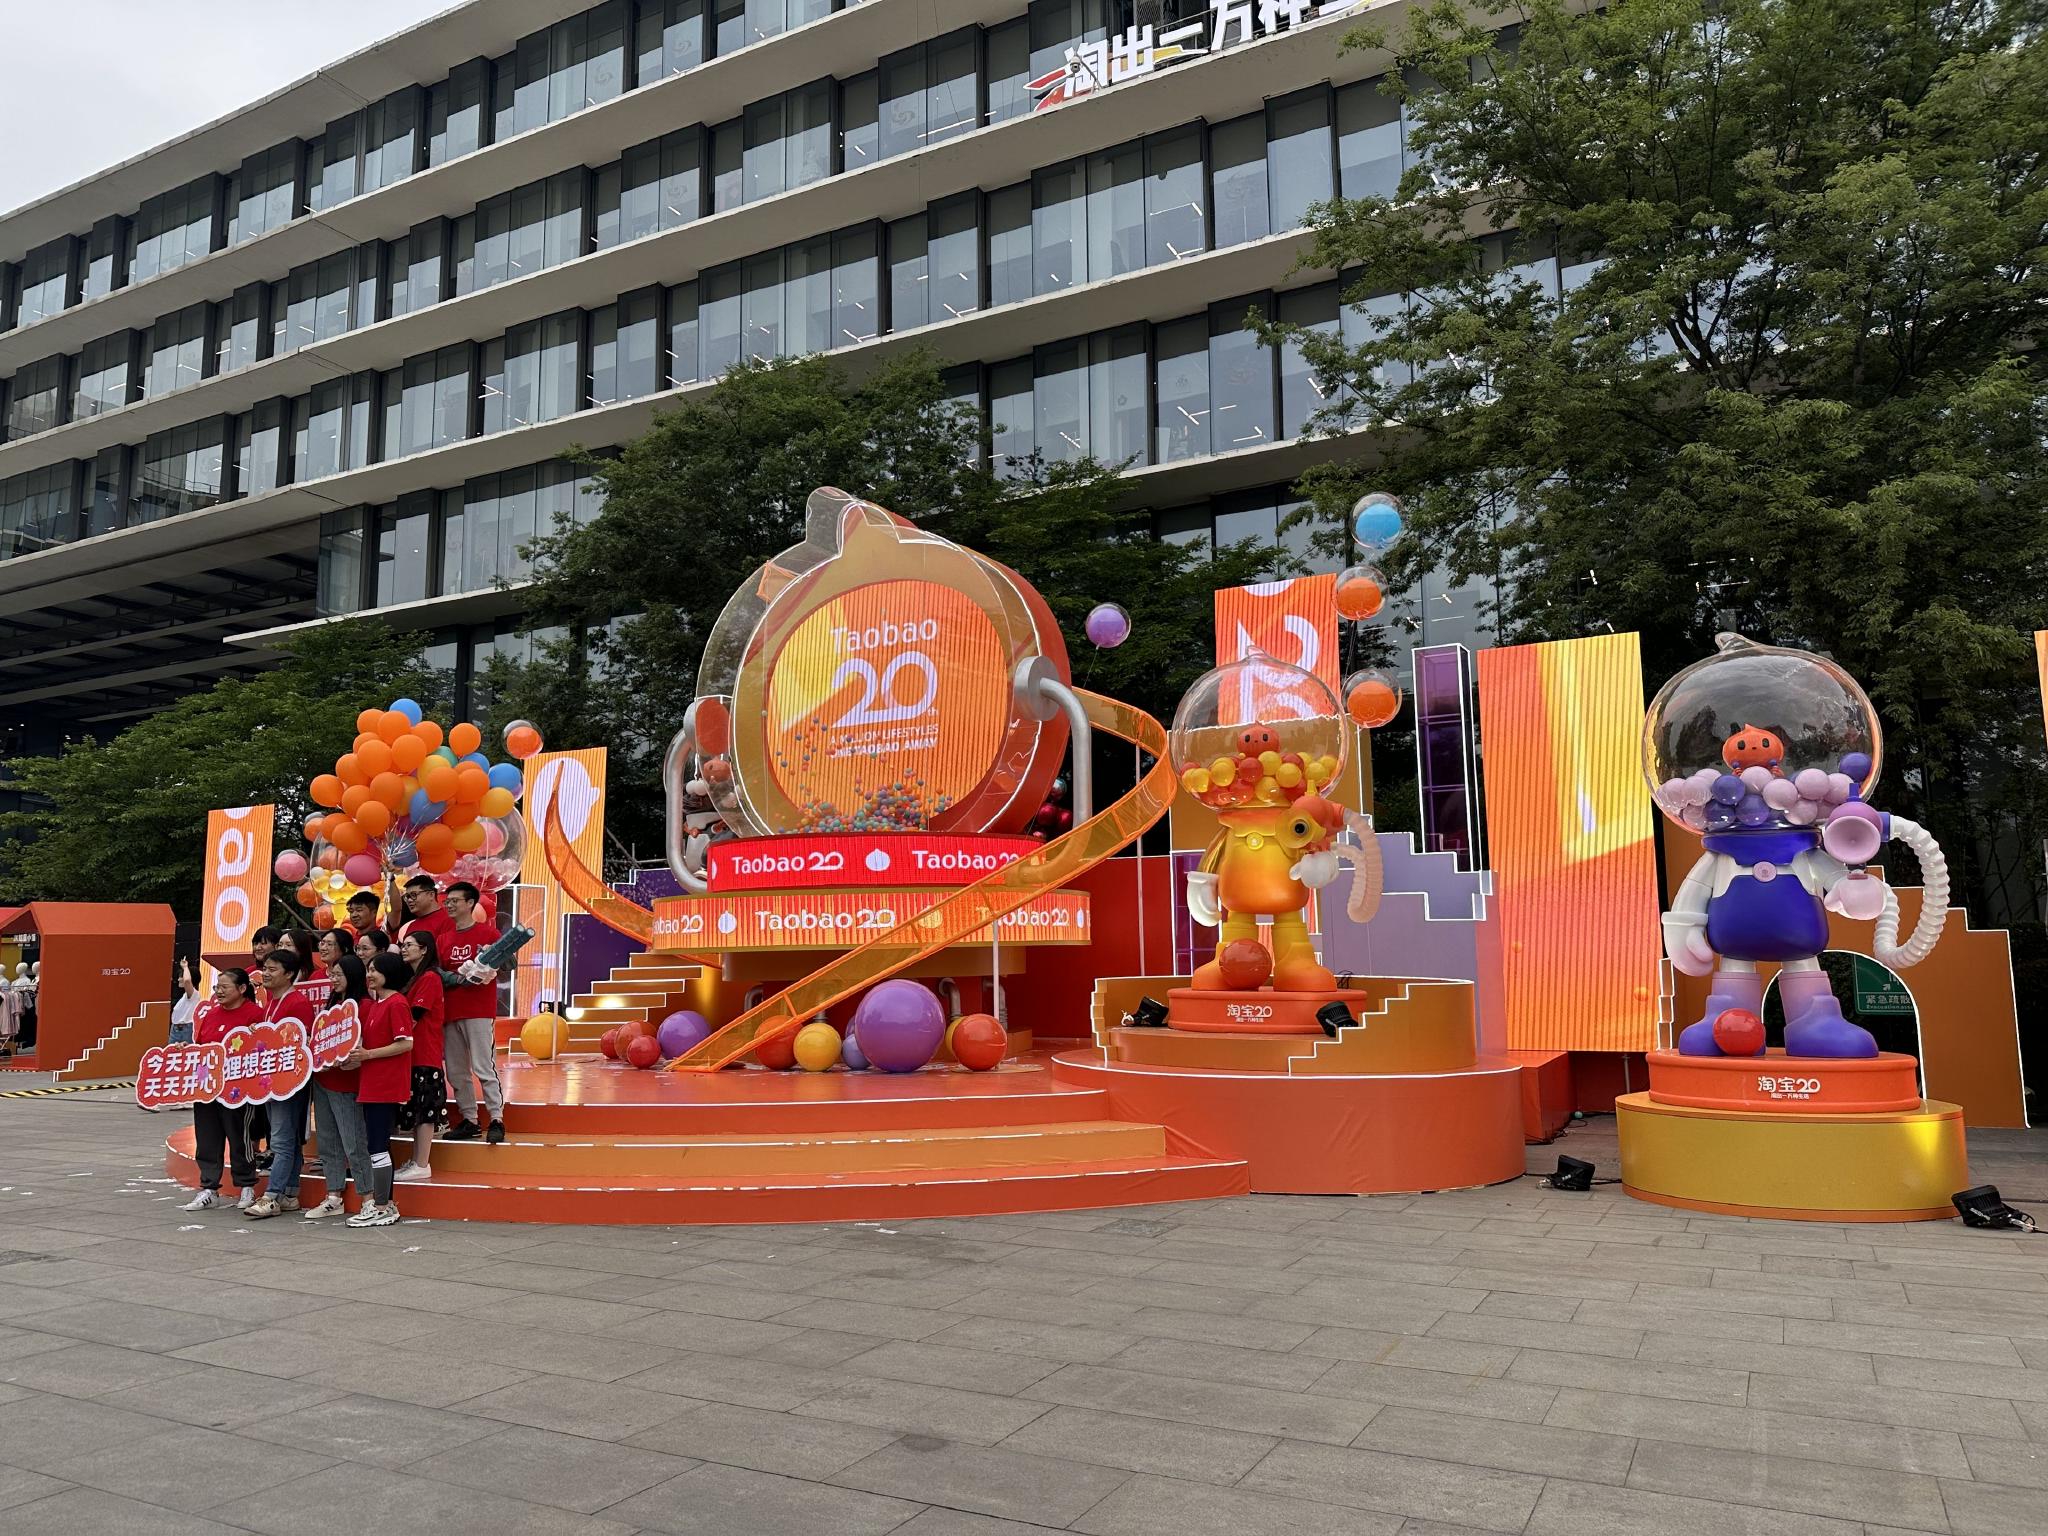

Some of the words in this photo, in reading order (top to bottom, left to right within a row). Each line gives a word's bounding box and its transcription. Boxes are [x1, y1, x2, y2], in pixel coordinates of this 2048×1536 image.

[1064, 0, 1362, 98] 淘出一万种
[830, 618, 938, 655] Taobao
[831, 650, 938, 728] 20
[840, 731, 880, 743] MLLION
[882, 723, 939, 740] LIFESTYLES
[904, 736, 938, 750] AWAY
[732, 854, 805, 875] Taobao
[911, 850, 997, 870] Taobao
[755, 909, 853, 930] Taobao
[1227, 1004, 1272, 1018] 淘宝20
[147, 1050, 219, 1074] 今天开心
[143, 1074, 217, 1098] 天天开心
[1757, 1076, 1821, 1093] 淘宝20
